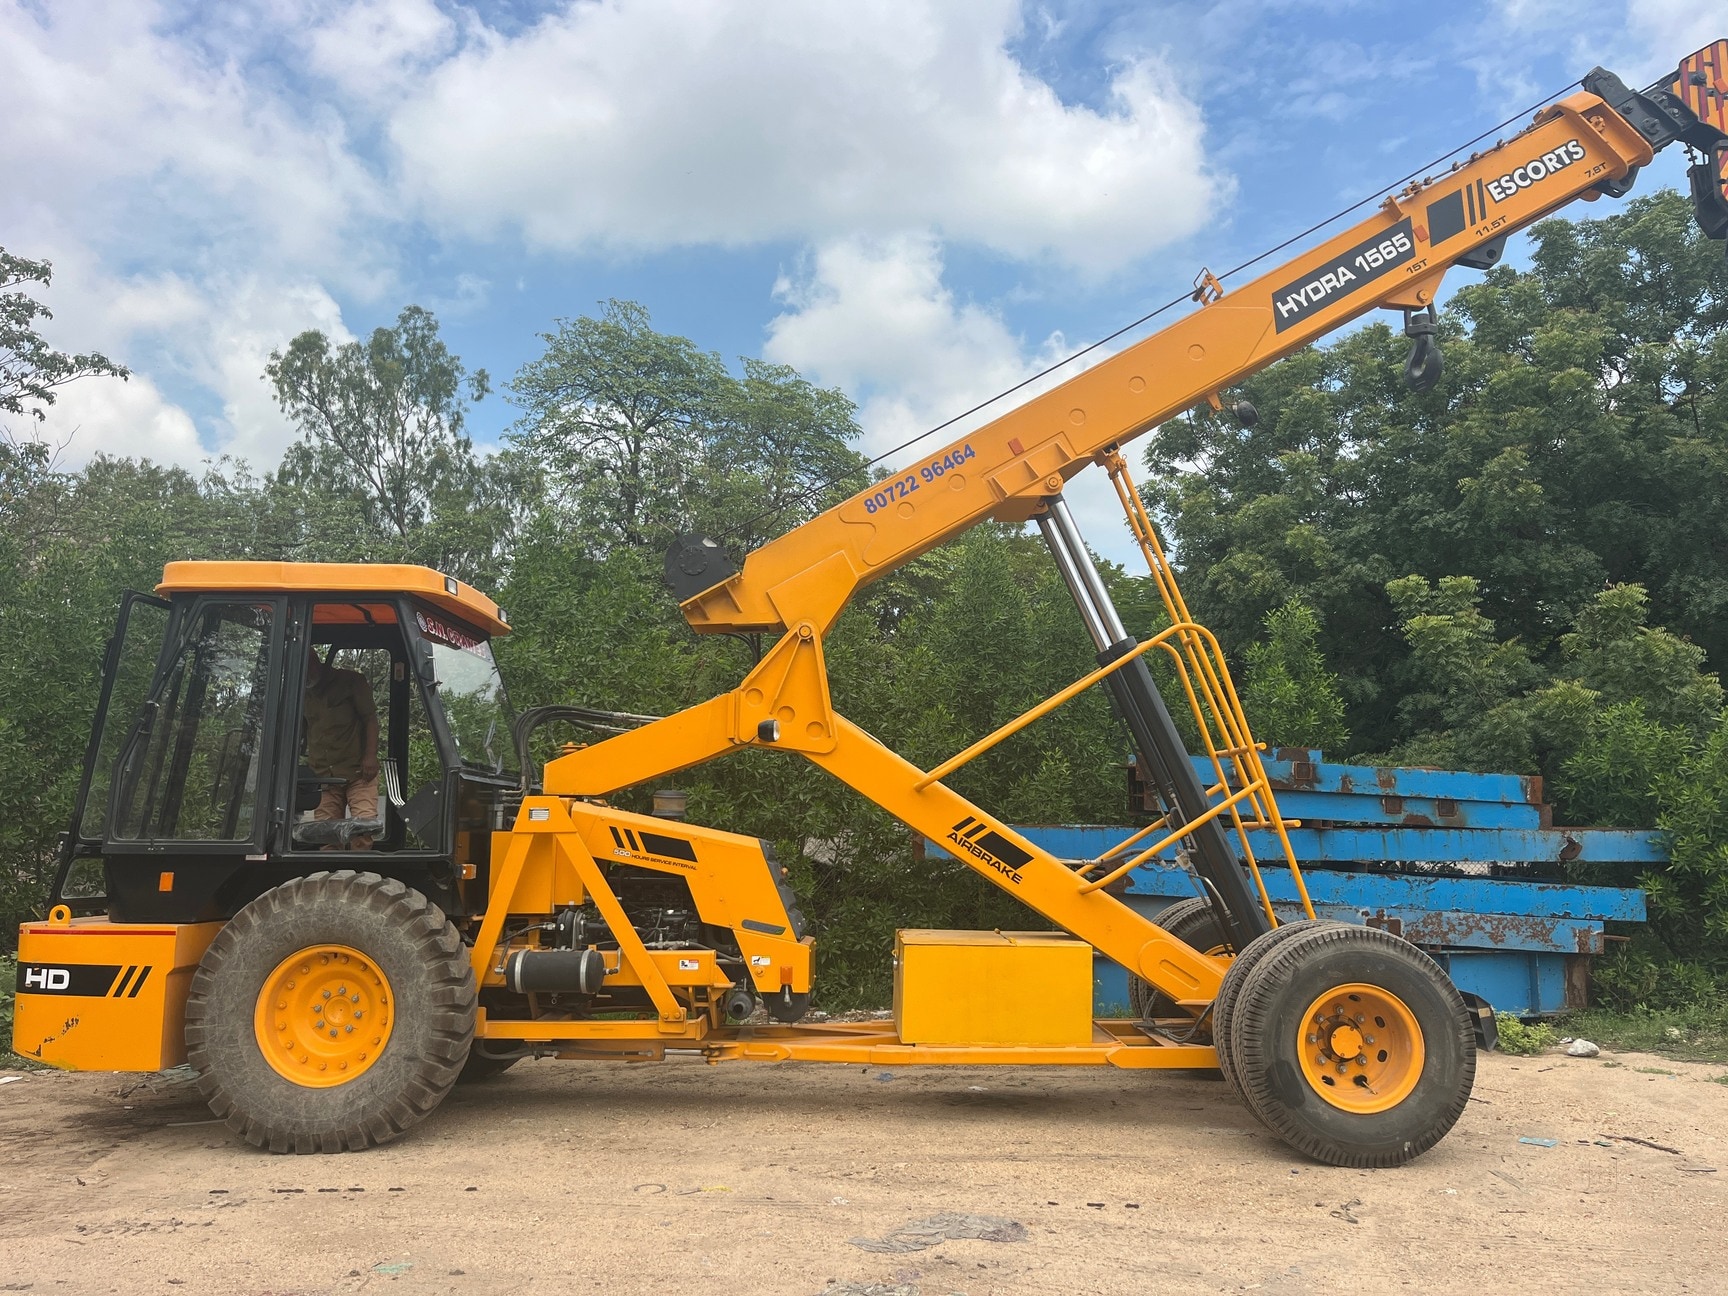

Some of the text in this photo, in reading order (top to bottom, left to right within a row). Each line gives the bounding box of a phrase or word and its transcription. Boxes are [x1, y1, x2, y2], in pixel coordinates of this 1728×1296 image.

[1485, 140, 1585, 203] ESCORTS
[1475, 215, 1506, 236] 11.5T
[1276, 232, 1412, 318] HYDRA 1565
[1406, 258, 1427, 274] 15T
[864, 443, 975, 514] 80722 96464
[613, 848, 698, 870] 500 HOURS SERVICE INTERVAL
[946, 832, 1023, 885] AIRBRAKE
[25, 968, 70, 990] HD
